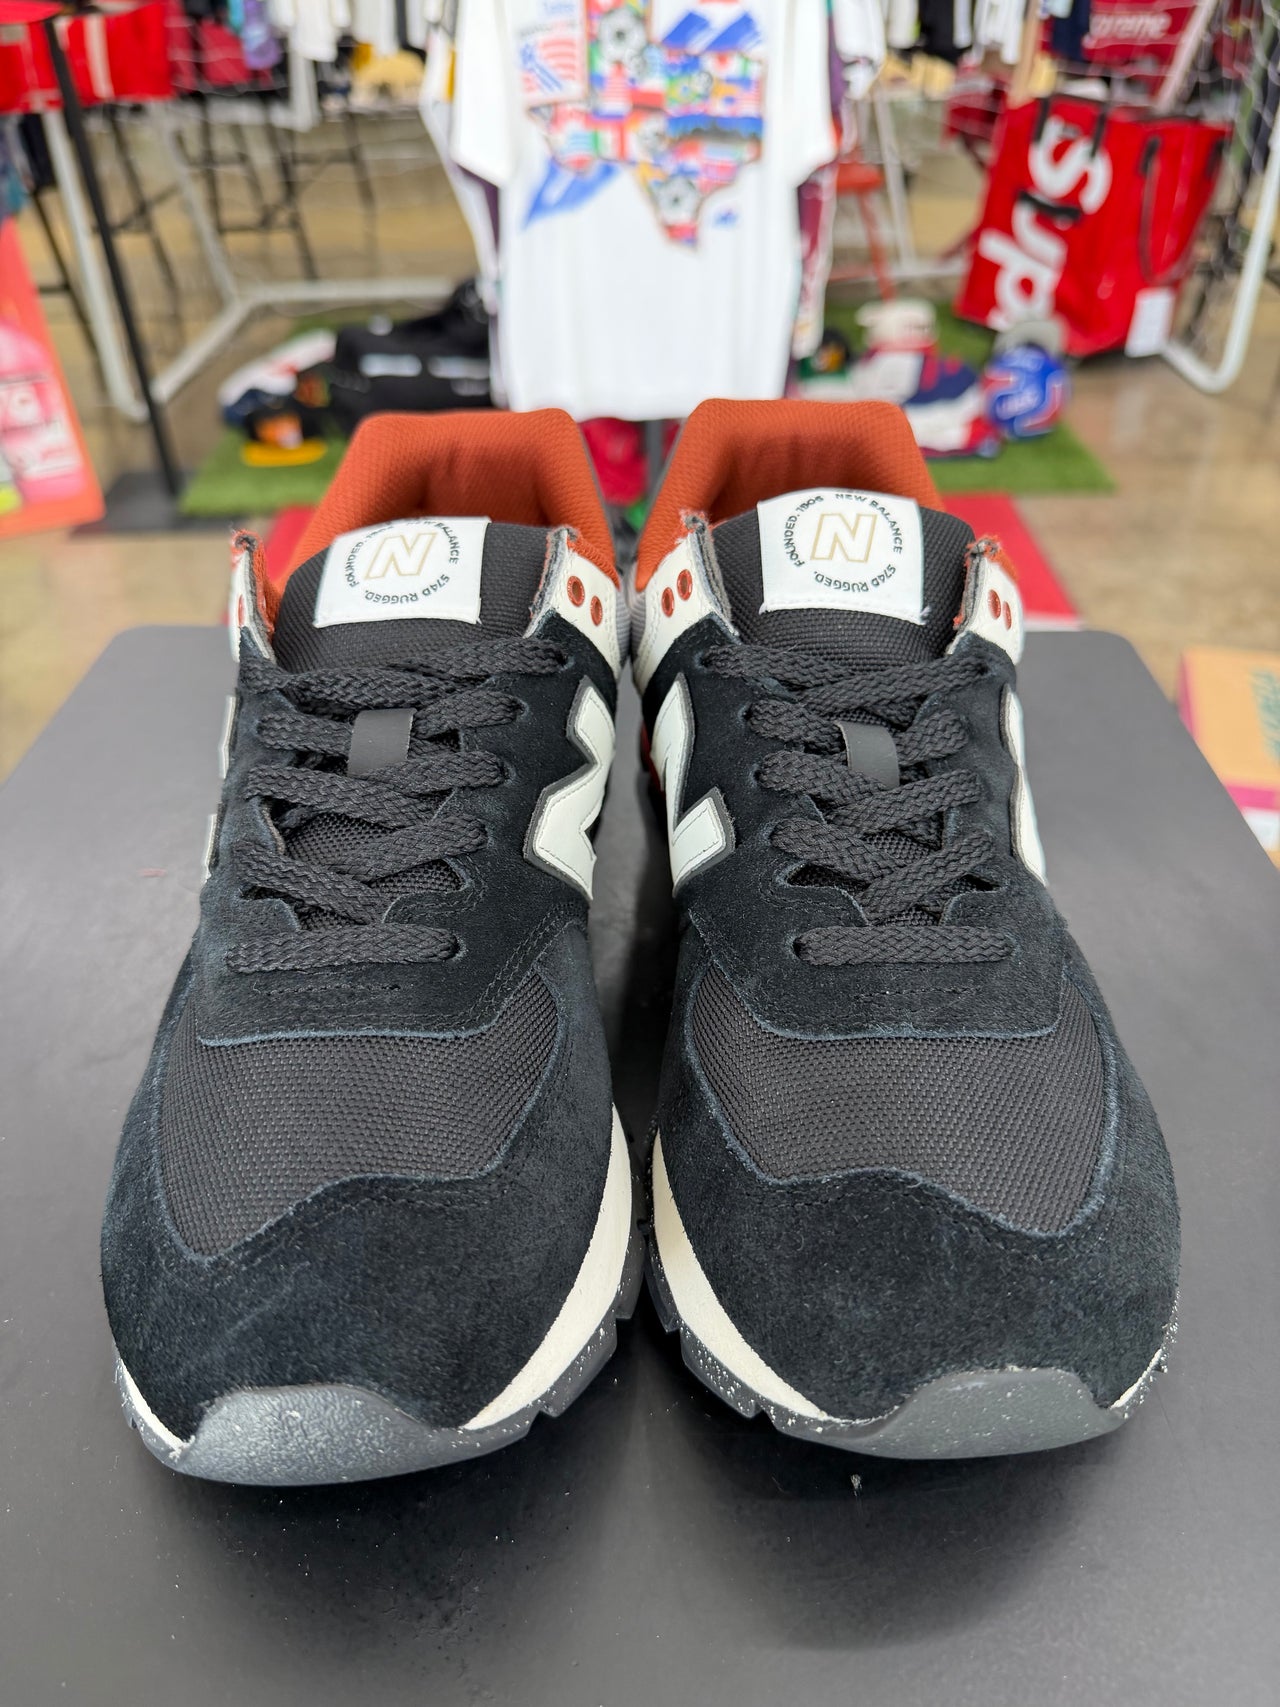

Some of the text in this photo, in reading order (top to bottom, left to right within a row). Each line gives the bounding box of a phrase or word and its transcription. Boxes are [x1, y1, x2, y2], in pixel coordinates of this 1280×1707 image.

[1083, 12, 1172, 48] preme
[810, 512, 878, 564] N
[835, 493, 903, 554] NEW BALANCE
[364, 532, 438, 580] N
[365, 589, 419, 604] RUGGED.
[813, 571, 869, 593] RUGGED.
